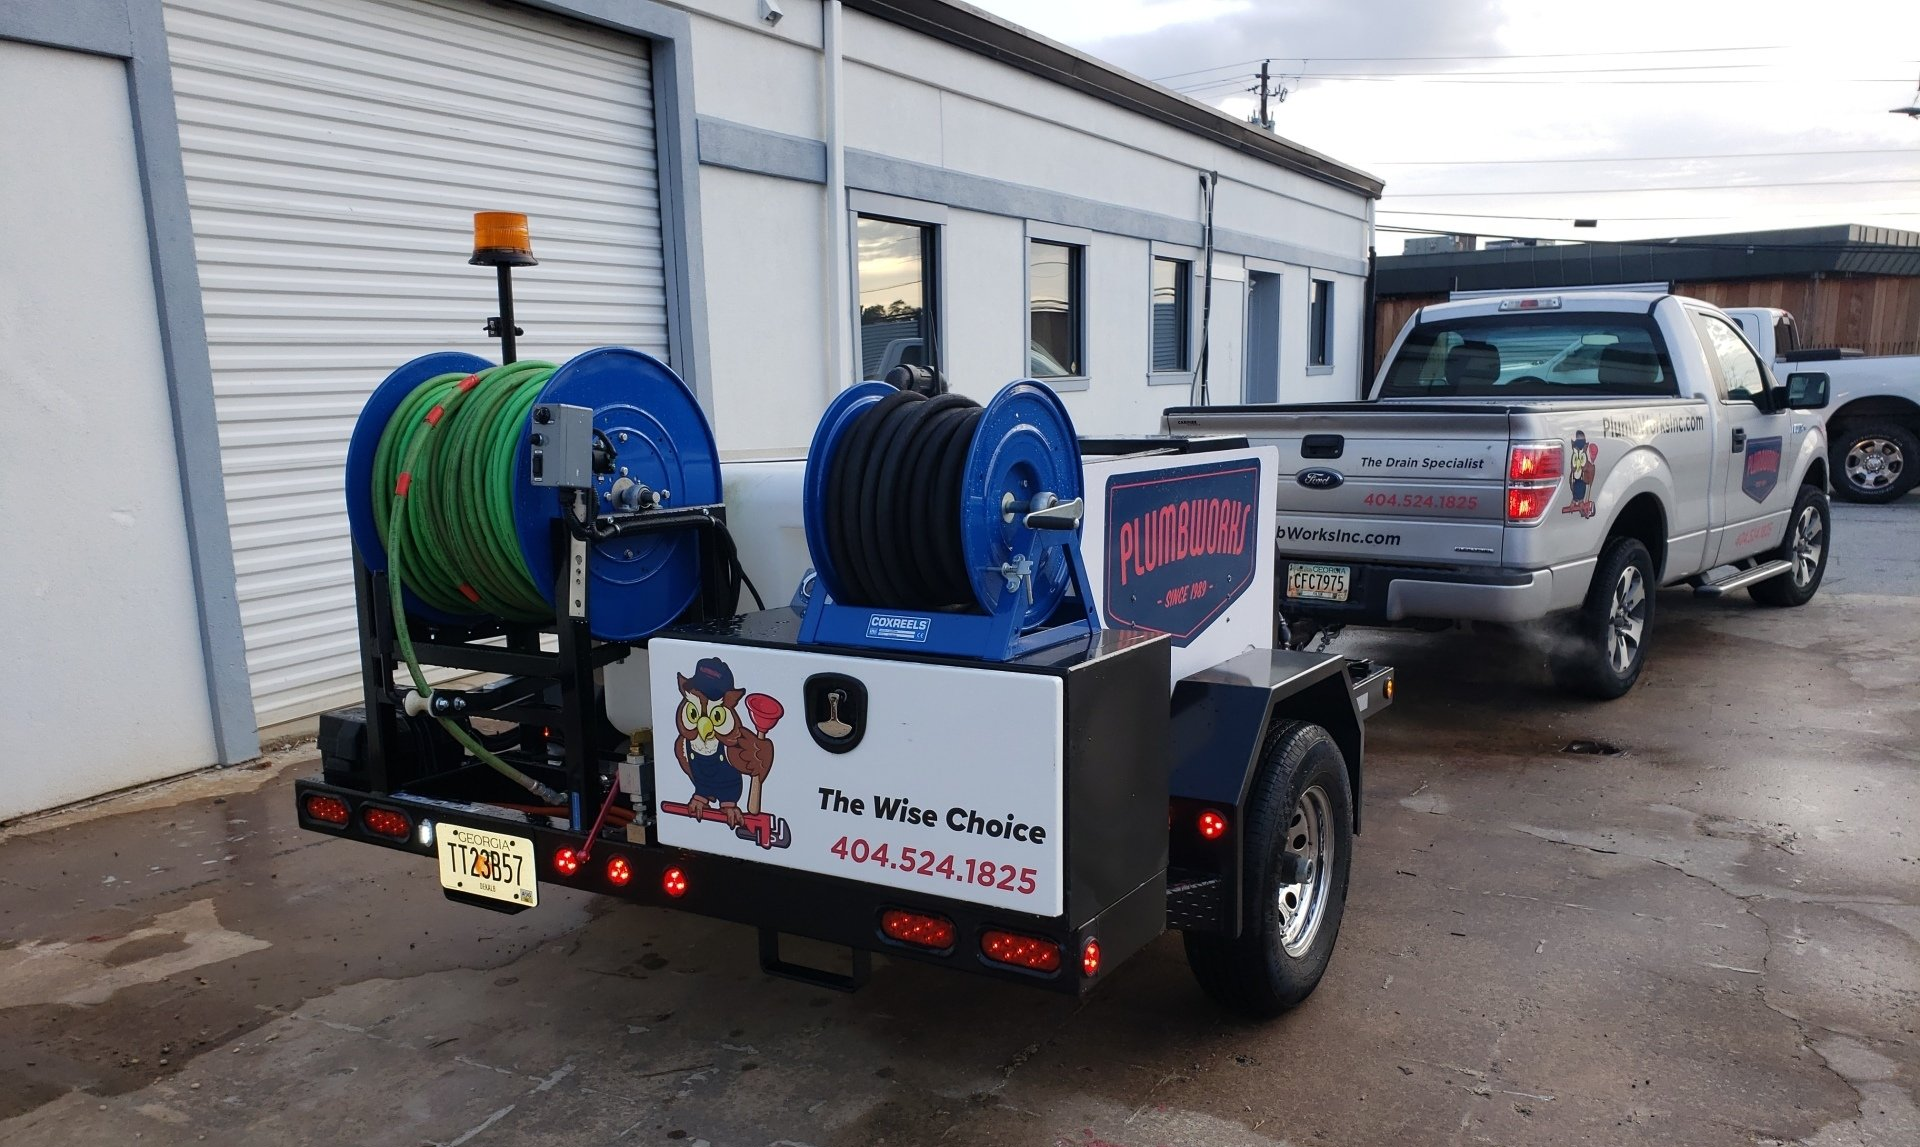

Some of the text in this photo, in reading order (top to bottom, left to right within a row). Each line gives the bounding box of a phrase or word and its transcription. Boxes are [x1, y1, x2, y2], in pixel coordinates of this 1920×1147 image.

[1361, 457, 1484, 470] The Drain Specialist
[1304, 472, 1330, 485] Ford
[1363, 493, 1478, 511] 404.524.1825
[1120, 498, 1251, 586] PLUMBWORKS
[1294, 573, 1344, 592] CFC7975
[1165, 580, 1208, 608] SINCE 1989
[871, 617, 927, 630] COXREELS
[818, 787, 1047, 845] The Wise Choice
[458, 831, 510, 851] GEORGIA
[447, 842, 523, 886] TT23B57
[830, 836, 1038, 895] 404.524.1825
